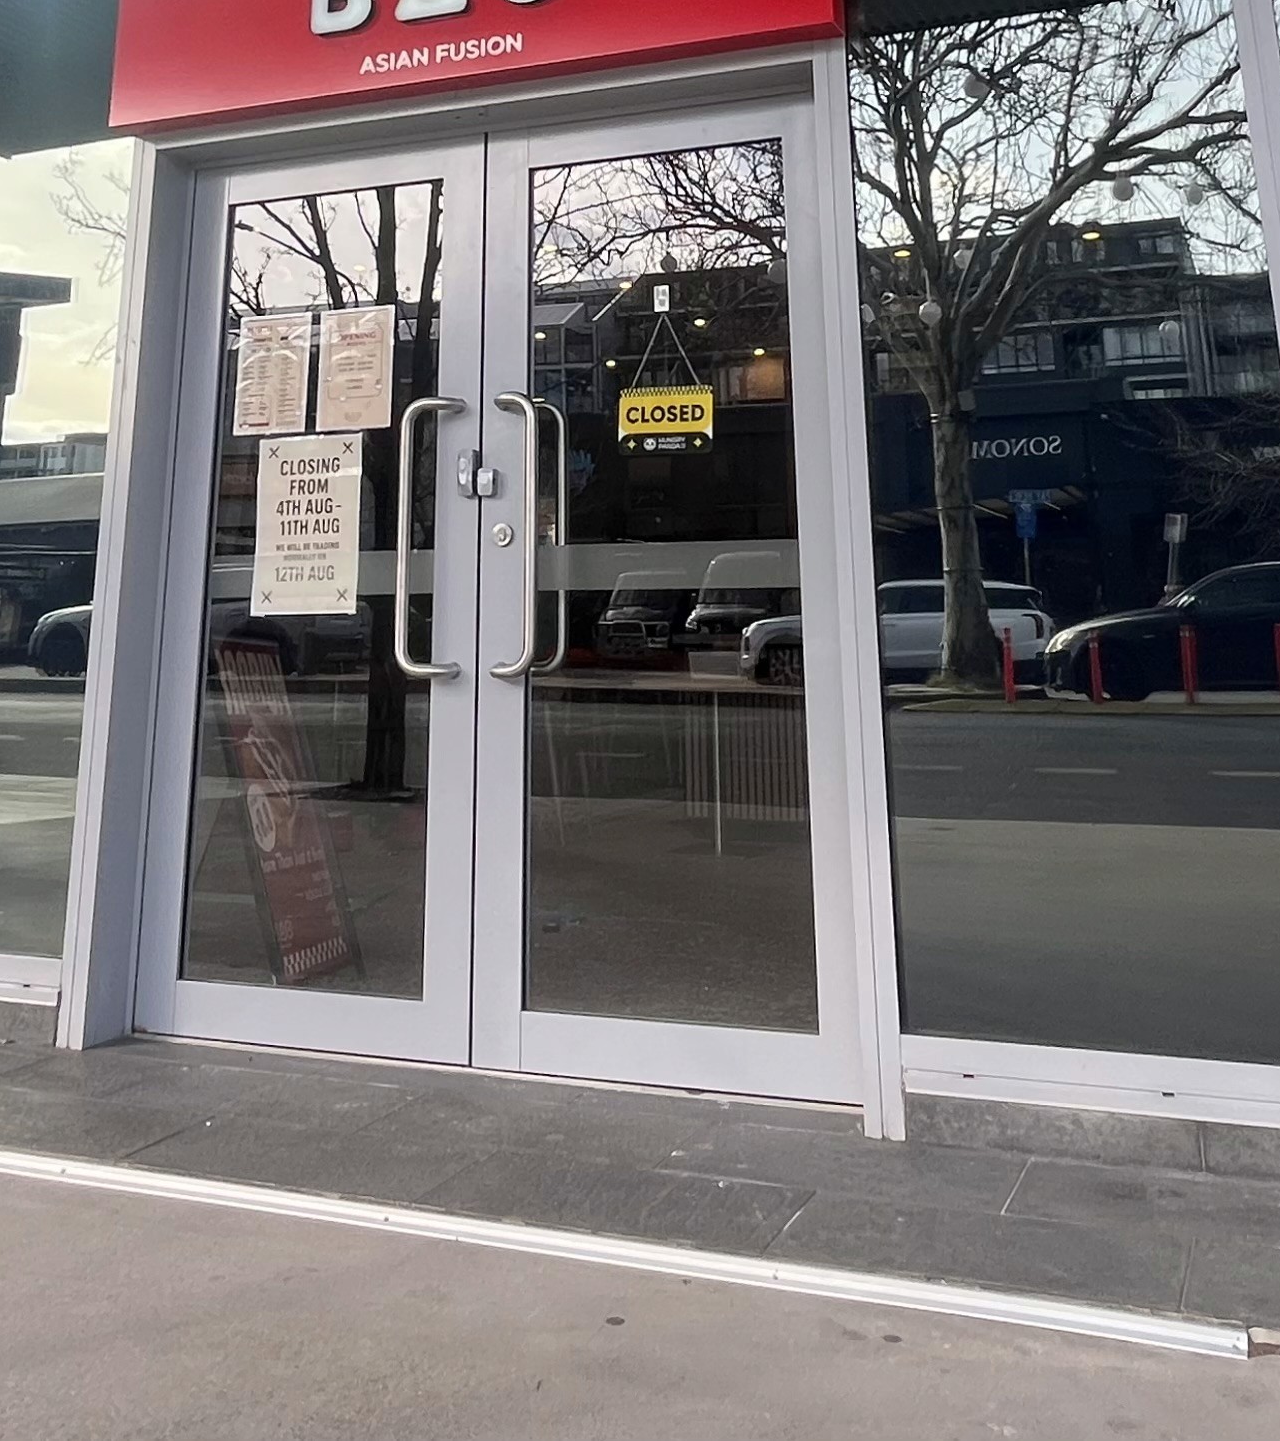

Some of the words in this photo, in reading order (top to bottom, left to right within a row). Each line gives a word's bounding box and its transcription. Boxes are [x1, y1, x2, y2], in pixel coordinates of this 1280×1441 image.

[359, 46, 429, 75] ASIAN
[435, 32, 523, 64] FUSION
[626, 404, 705, 424] CLOSED
[280, 457, 340, 476] CLOSING
[290, 478, 329, 496] FROM
[276, 499, 301, 516] 4TH
[280, 519, 309, 536] 11TH
[312, 517, 340, 535] AUG
[275, 566, 304, 582] 12TH
[307, 565, 335, 581] AUG
